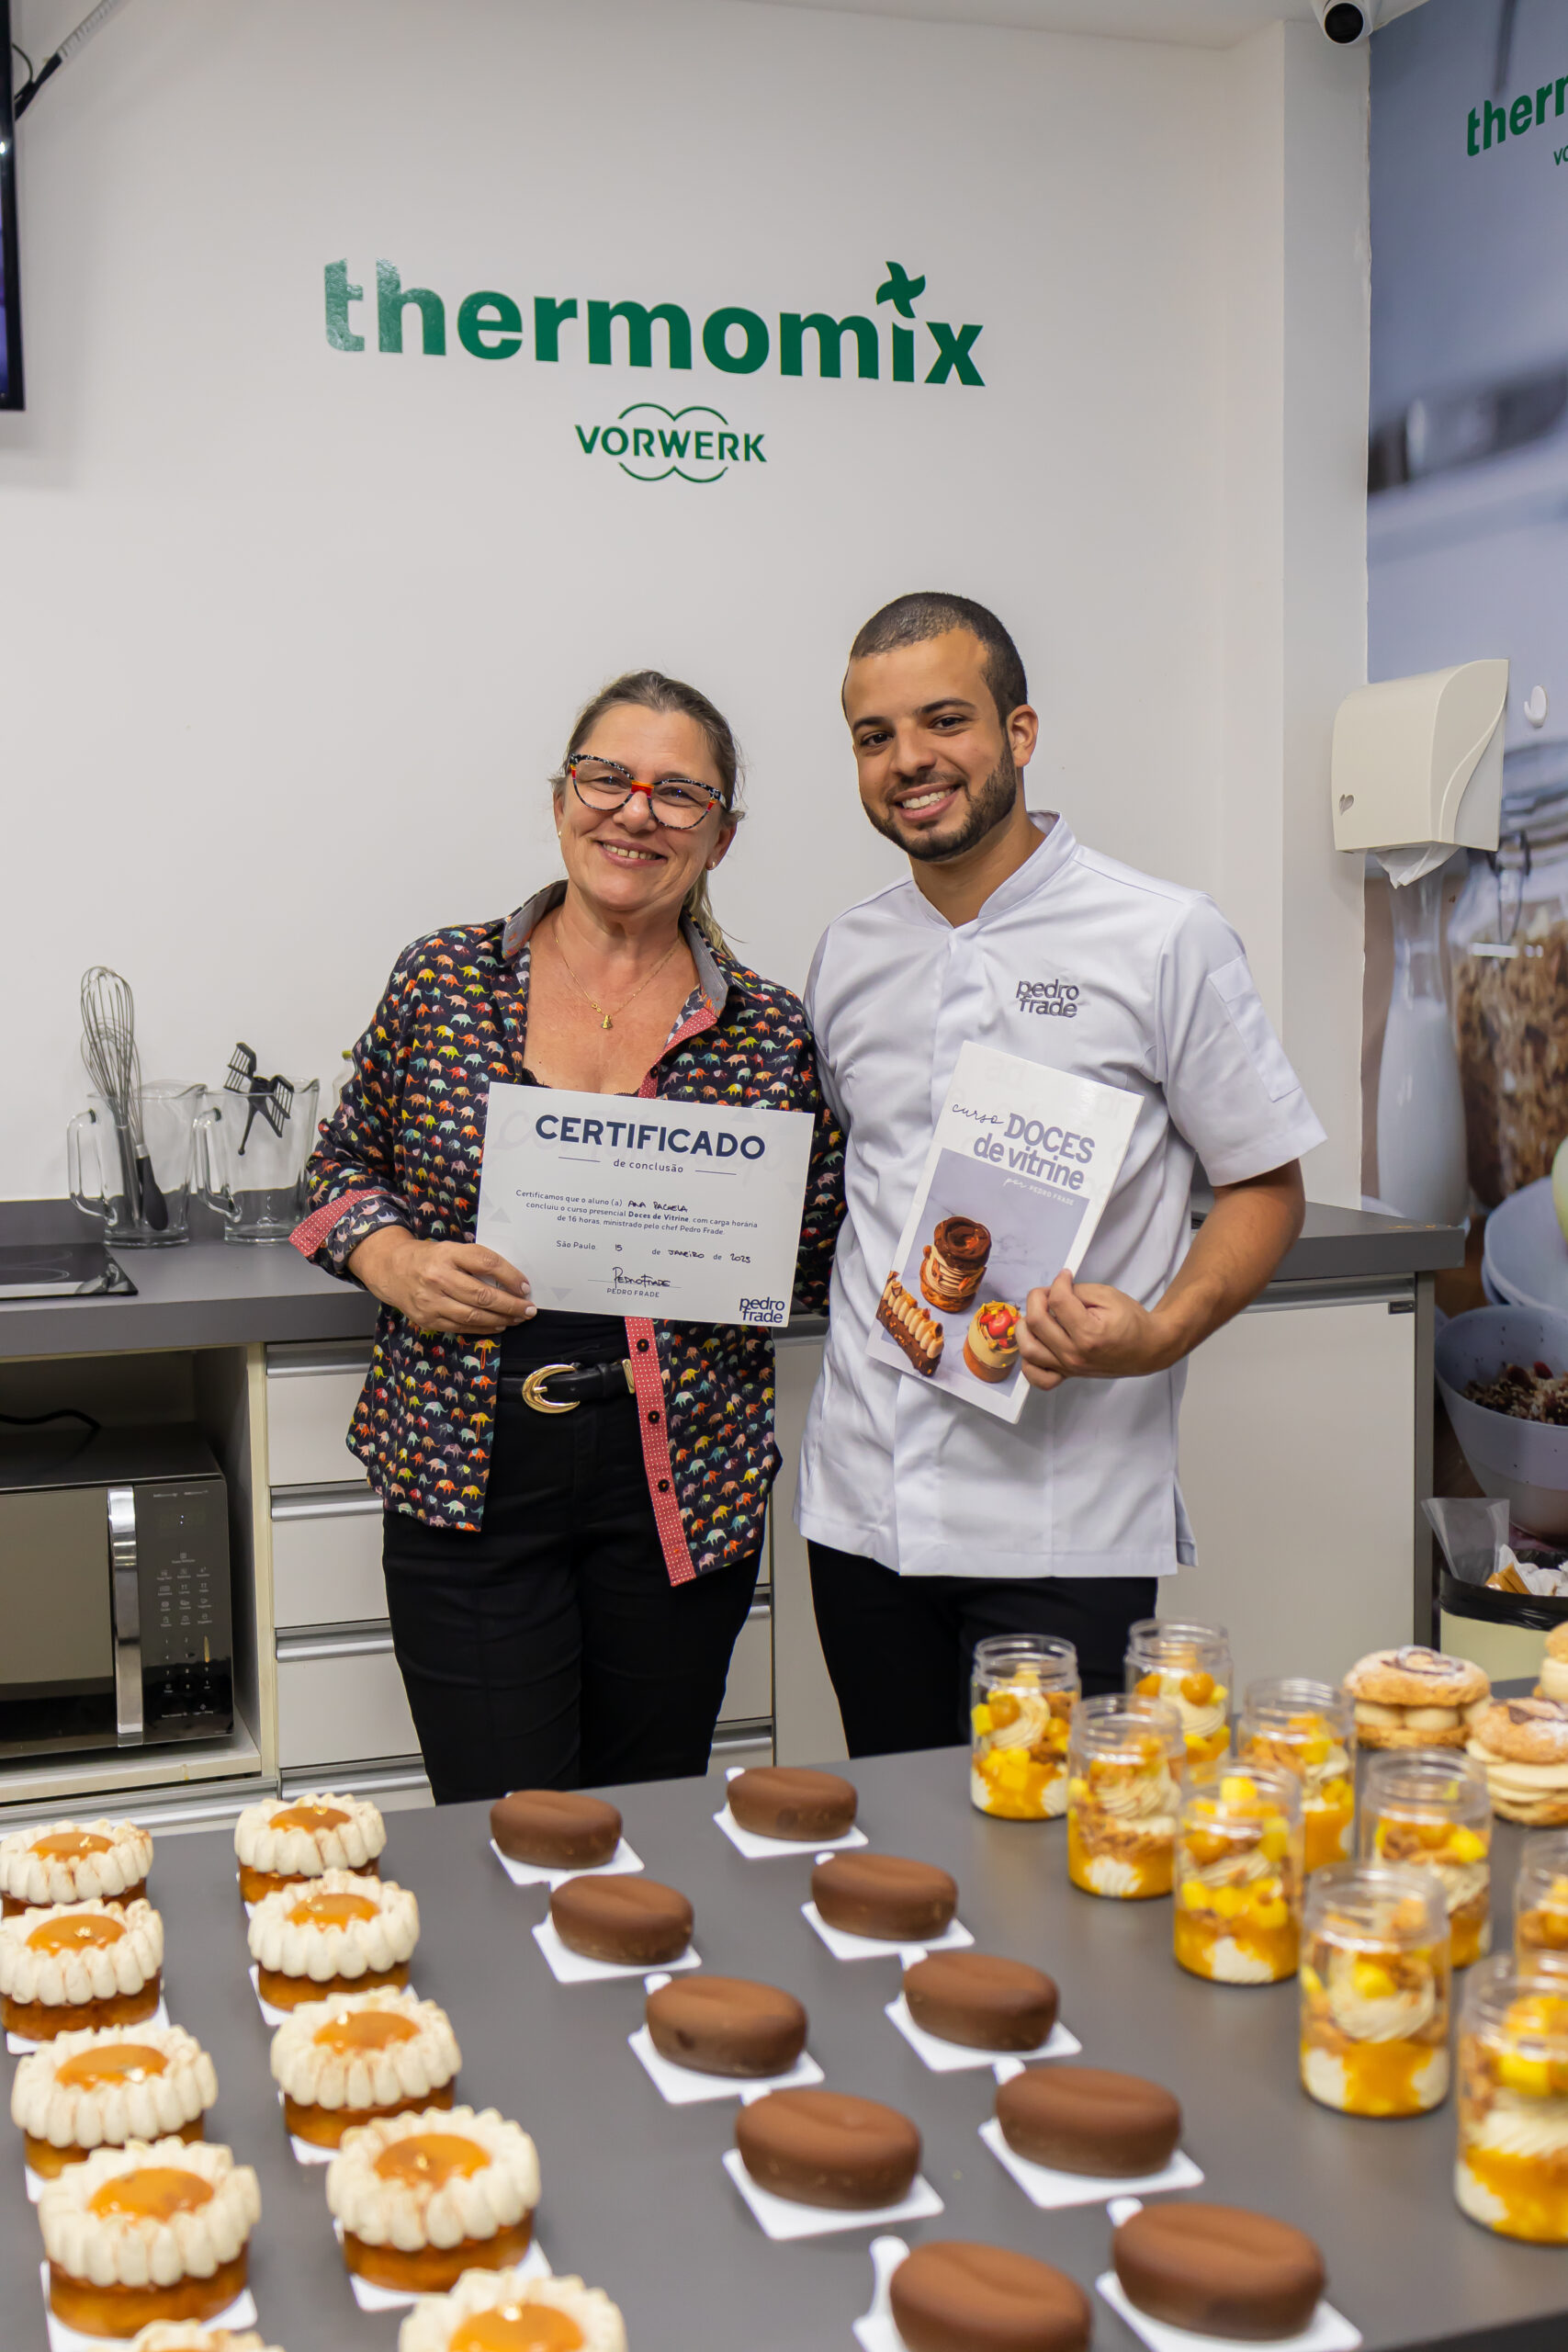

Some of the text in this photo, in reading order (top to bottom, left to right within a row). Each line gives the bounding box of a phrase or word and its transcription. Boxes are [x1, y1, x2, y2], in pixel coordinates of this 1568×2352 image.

[323, 257, 986, 387] thermomix
[574, 424, 767, 463] VORWERK
[1015, 978, 1080, 1001] pedro
[1019, 995, 1077, 1018] frade
[535, 1114, 766, 1160] CERTIFICADO
[952, 1102, 1096, 1164] curso DOCES
[613, 1158, 684, 1173] de conclusão
[973, 1132, 1085, 1191] de vitrine
[515, 1189, 564, 1202] Certificamos
[565, 1195, 581, 1204] que
[587, 1197, 609, 1205] aluno
[611, 1198, 623, 1207] (a)
[525, 1201, 558, 1211] concluiu
[589, 1208, 626, 1217] presencial
[627, 1210, 651, 1219] Doces
[652, 1212, 661, 1220] de
[693, 1216, 708, 1225] com
[709, 1219, 730, 1227] carga
[557, 1214, 567, 1222] de
[568, 1215, 577, 1223] 16
[603, 1218, 643, 1228] ministrado
[643, 1223, 660, 1231] pelo
[661, 1223, 678, 1232] chef
[680, 1224, 702, 1234] Pedro
[556, 1239, 571, 1249] São
[713, 1253, 723, 1261] de
[606, 1287, 660, 1298] PEDRO FRADE
[739, 1296, 785, 1312] pedro
[741, 1306, 784, 1324] frade
